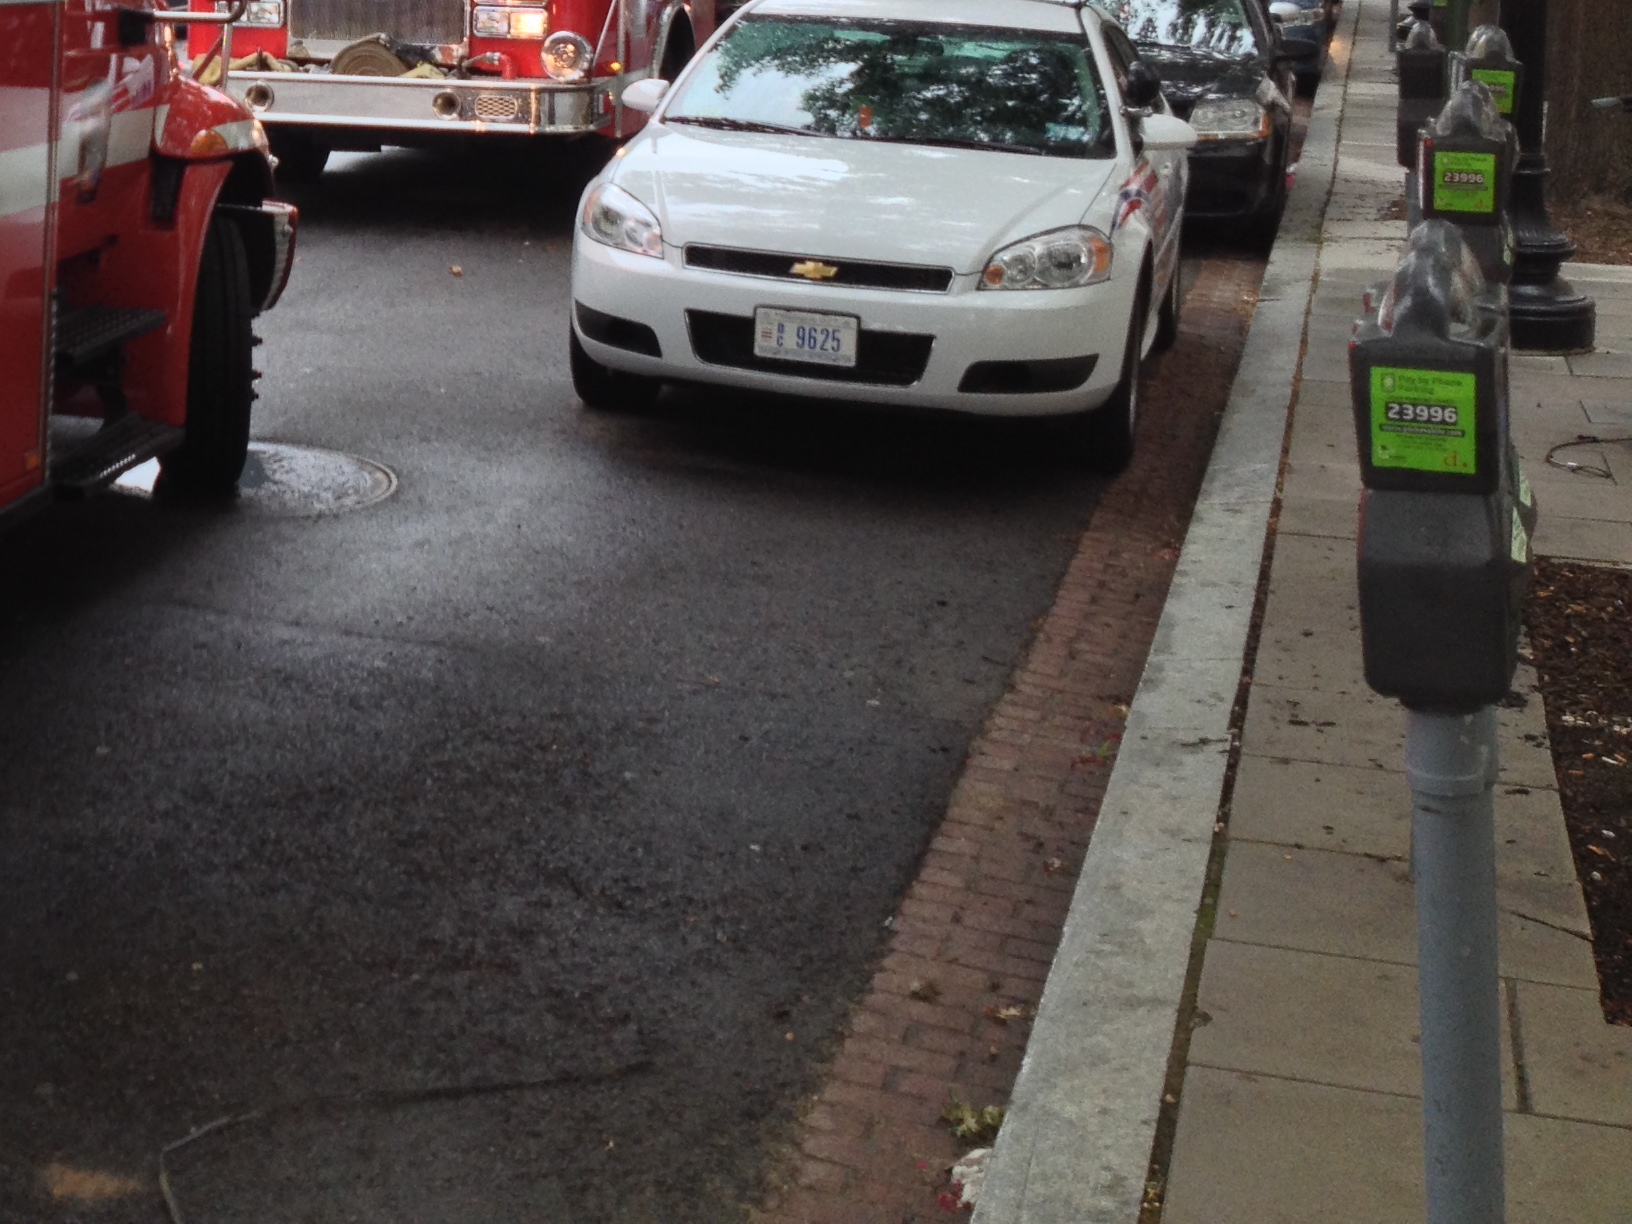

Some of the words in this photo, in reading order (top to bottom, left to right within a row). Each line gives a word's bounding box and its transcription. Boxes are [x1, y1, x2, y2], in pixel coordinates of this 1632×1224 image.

[1443, 172, 1485, 184] 23996
[796, 325, 842, 353] 9625
[1388, 403, 1457, 423] 23996
